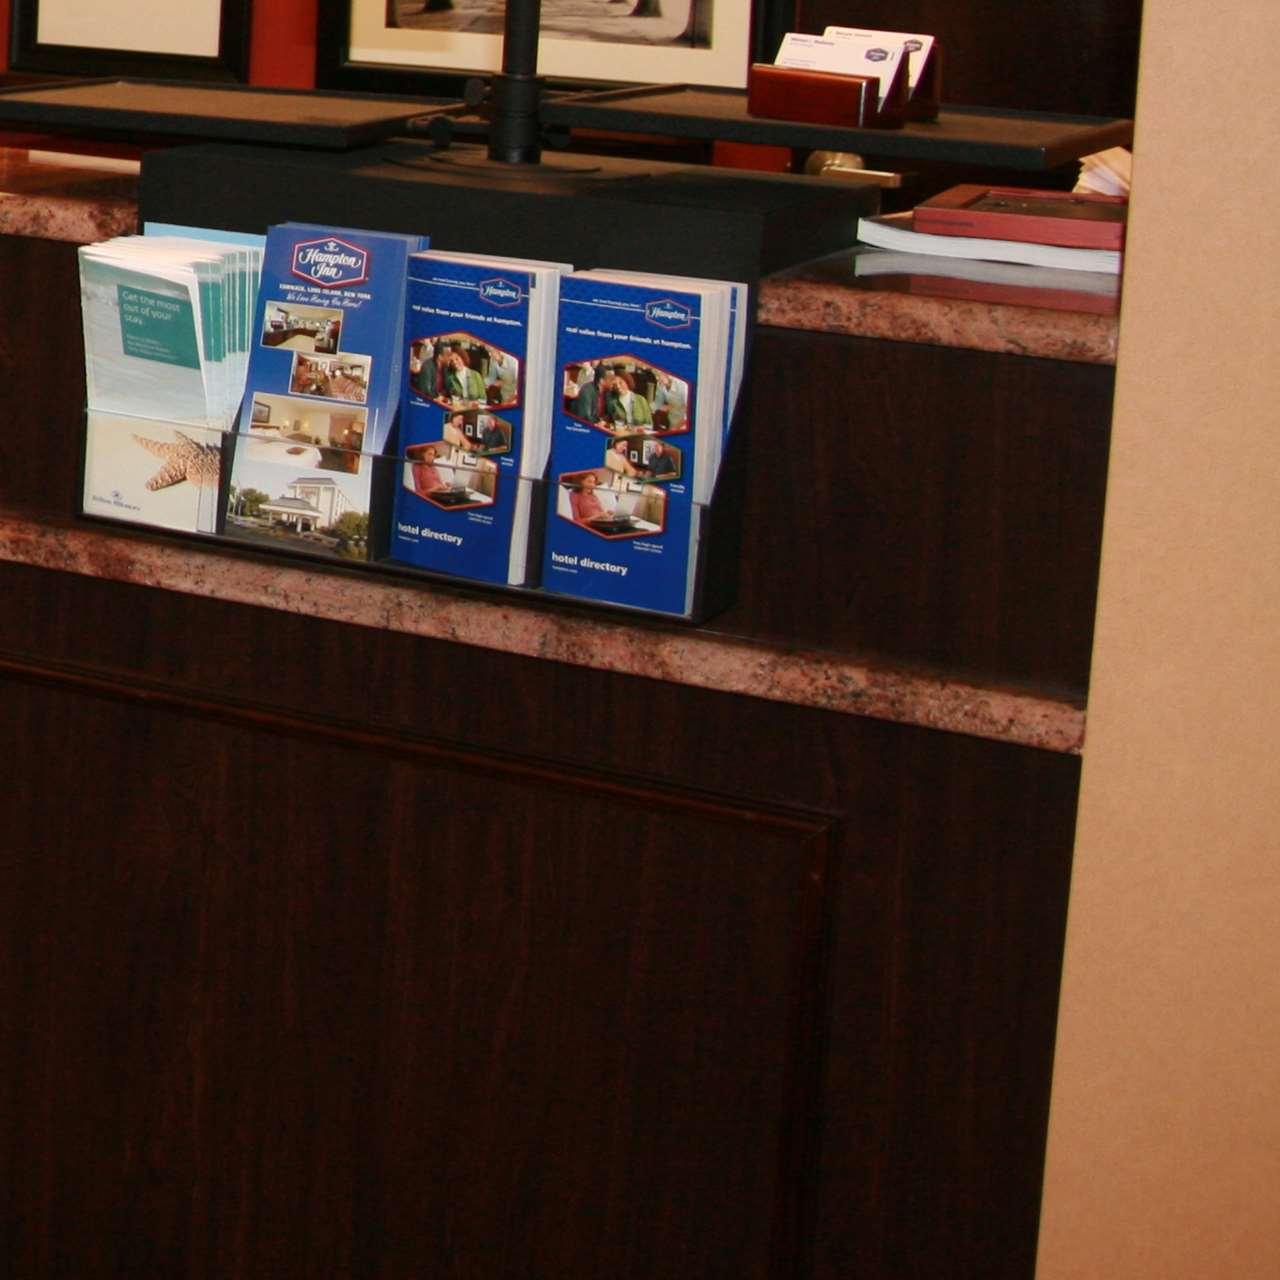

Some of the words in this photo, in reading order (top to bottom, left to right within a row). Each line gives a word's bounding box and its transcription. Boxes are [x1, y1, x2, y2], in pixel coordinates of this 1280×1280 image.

[298, 248, 362, 269] Hampton
[311, 263, 343, 279] Inn
[122, 290, 138, 301] Get
[140, 295, 155, 306] the
[156, 300, 181, 313] most
[483, 285, 518, 299] Hampton
[123, 303, 139, 313] out
[140, 306, 151, 318] of
[398, 522, 420, 536] hotel
[421, 527, 464, 547] directory
[551, 551, 578, 566] hotel
[579, 557, 629, 577] directory
